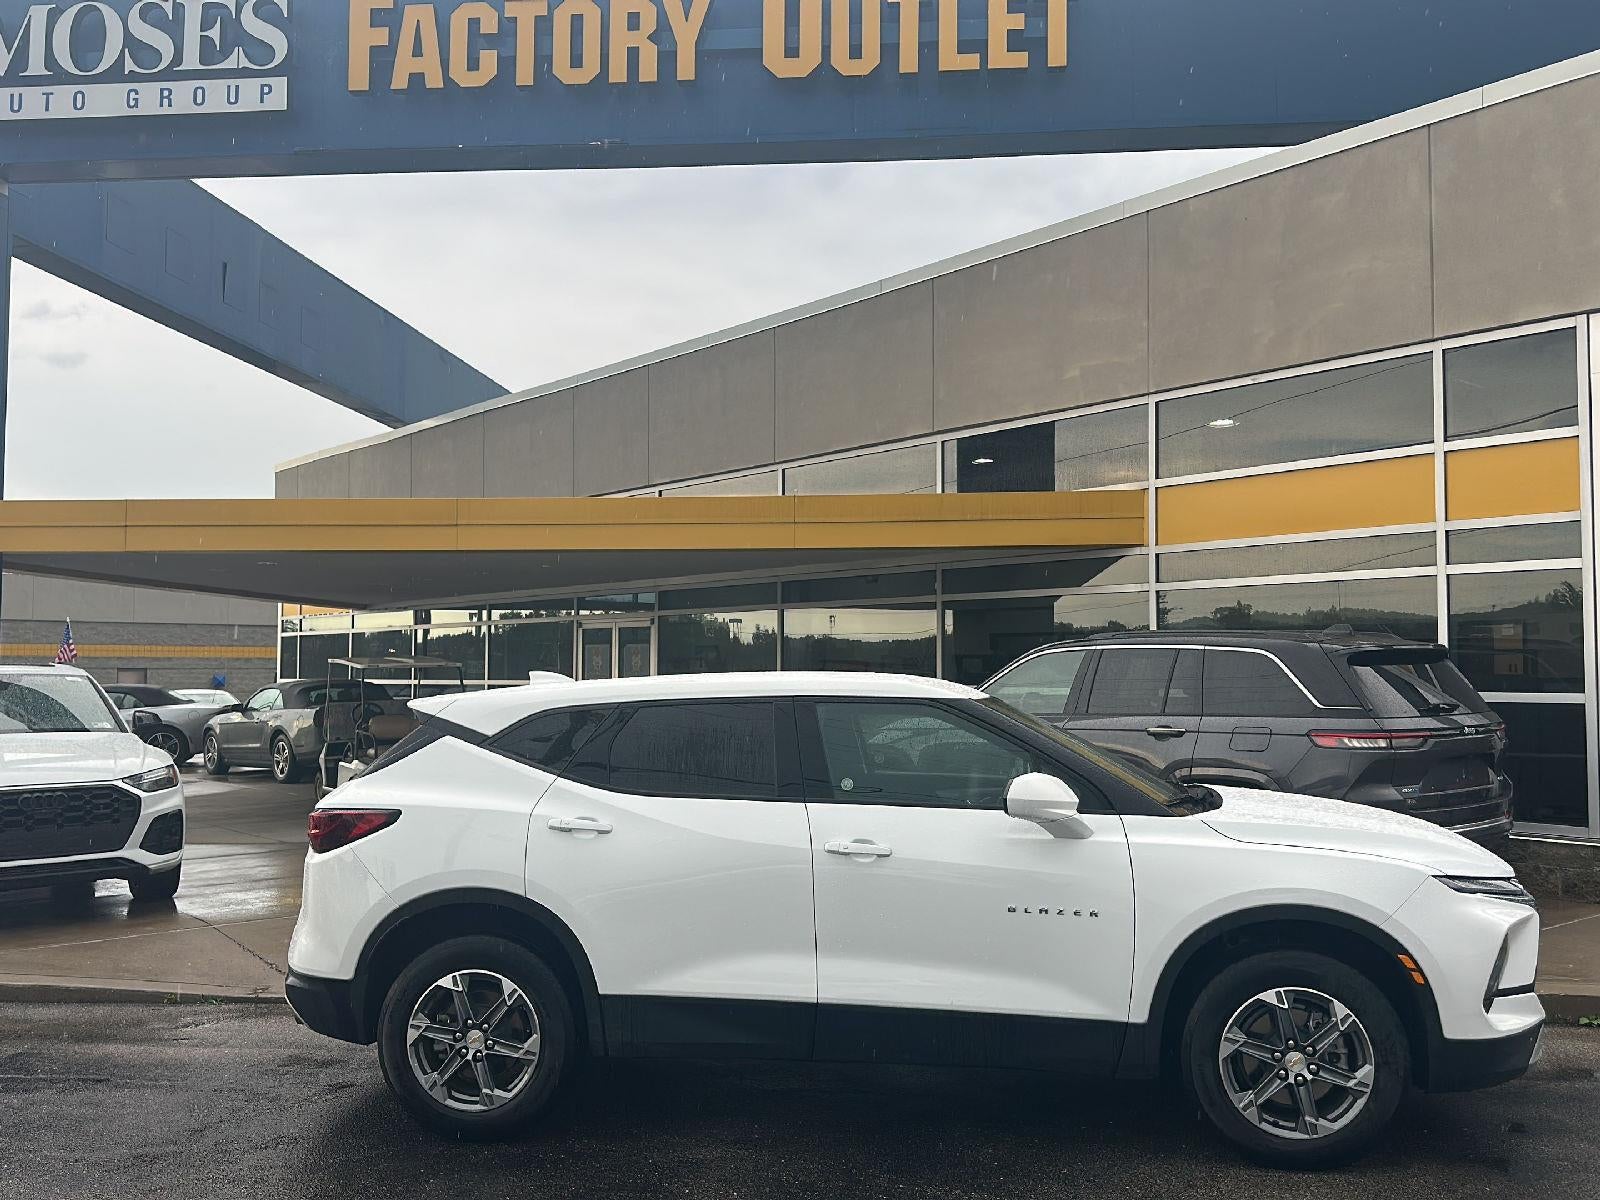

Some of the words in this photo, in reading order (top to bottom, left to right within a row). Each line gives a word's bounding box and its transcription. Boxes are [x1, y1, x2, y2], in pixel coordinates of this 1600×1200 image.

[0, 0, 288, 77] MOSES
[348, 0, 711, 91] FACTORY
[9, 90, 86, 113] UTO
[126, 83, 273, 109] GROUP
[1007, 905, 1099, 918] BLAZER
